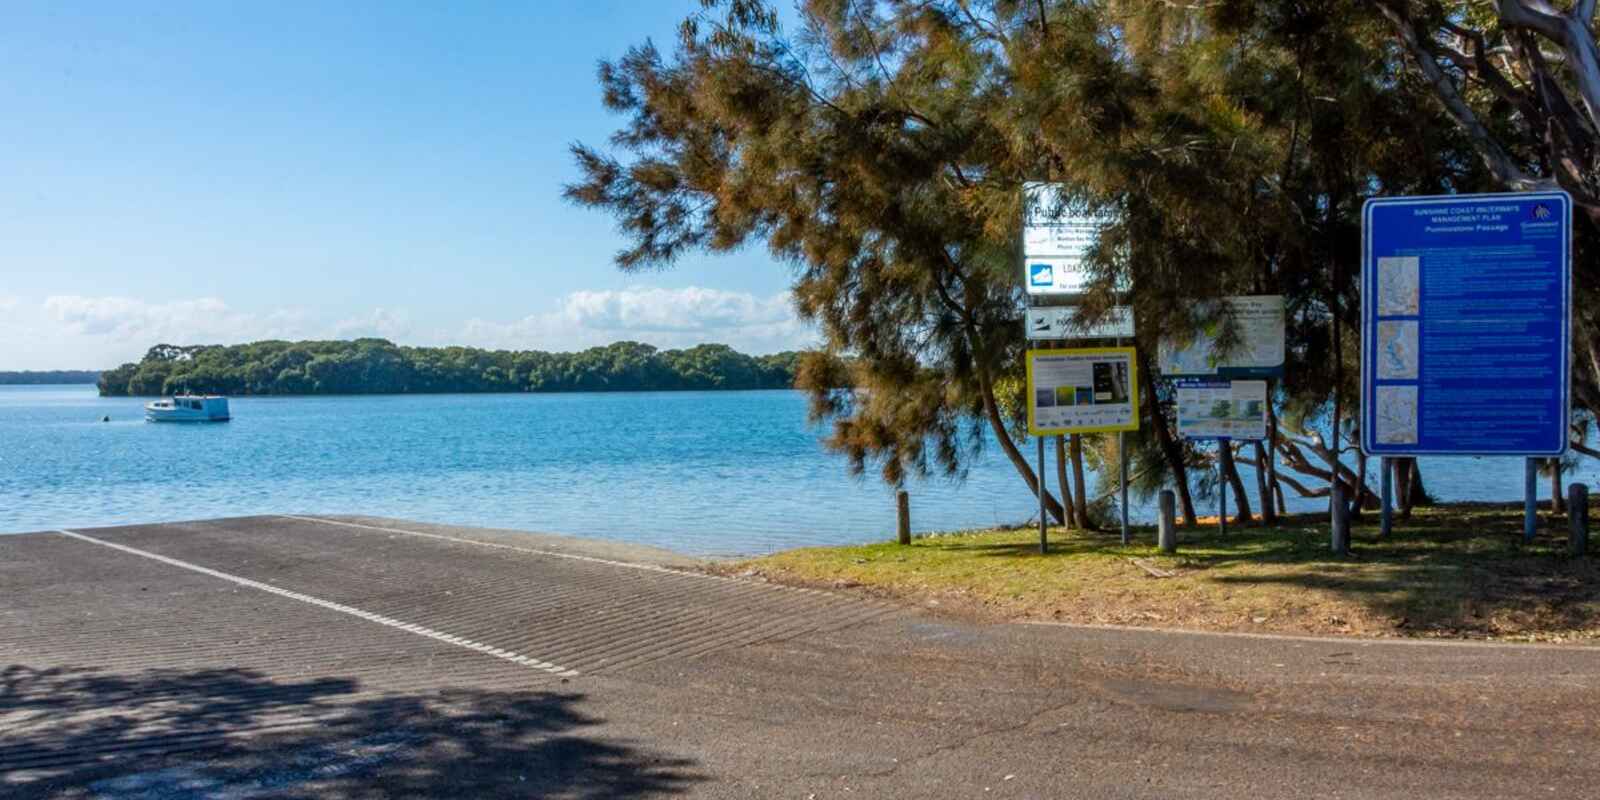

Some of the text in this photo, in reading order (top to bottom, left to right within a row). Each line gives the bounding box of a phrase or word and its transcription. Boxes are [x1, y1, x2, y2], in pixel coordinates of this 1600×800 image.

[1413, 208, 1449, 216] SUNSHINE
[1450, 207, 1475, 215] COAST
[1431, 214, 1502, 223] MANAGEMENT PLAN
[1476, 224, 1509, 232] Passage
